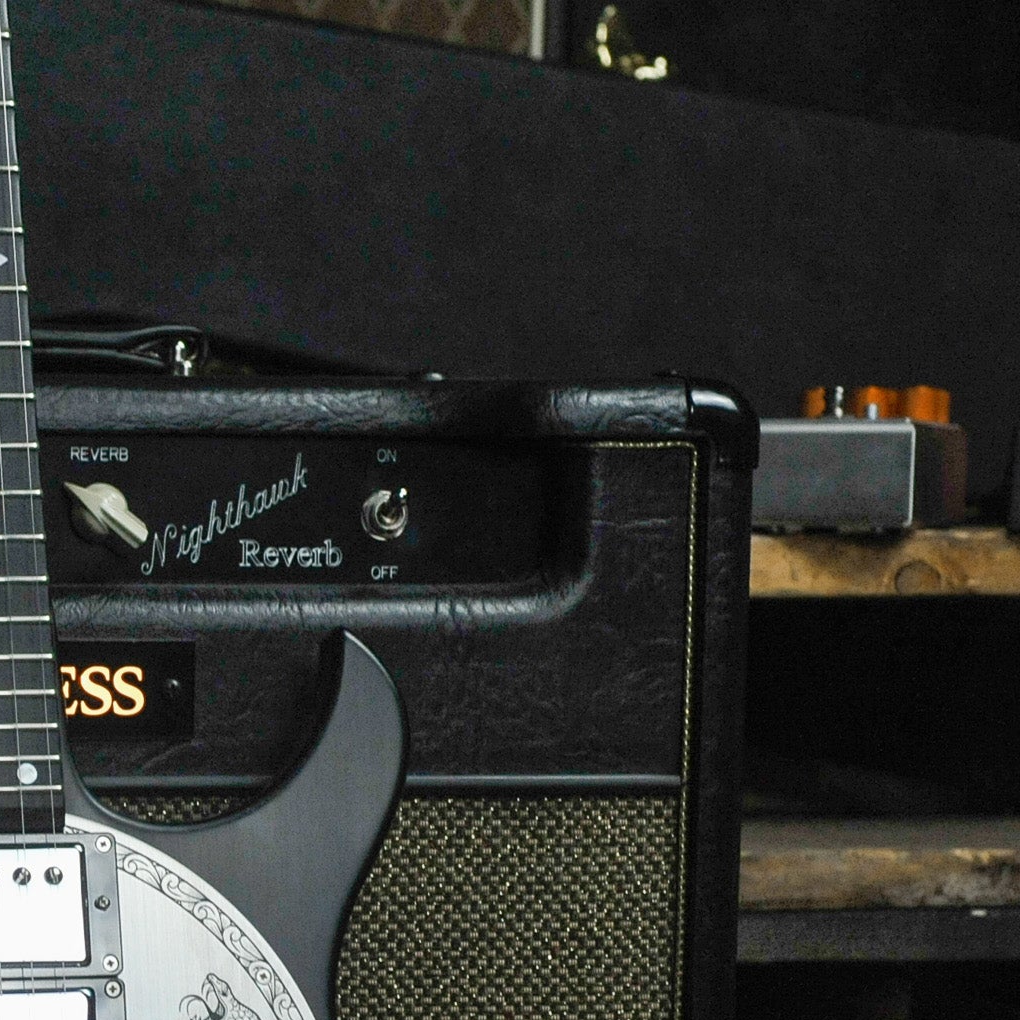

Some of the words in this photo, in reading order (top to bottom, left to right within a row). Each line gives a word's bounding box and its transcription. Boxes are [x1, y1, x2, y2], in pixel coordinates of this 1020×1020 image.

[70, 446, 129, 462] REVERB
[376, 447, 397, 463] ON
[141, 452, 308, 575] Nighthawk
[239, 539, 343, 568] Reverb
[370, 565, 399, 580] OFF
